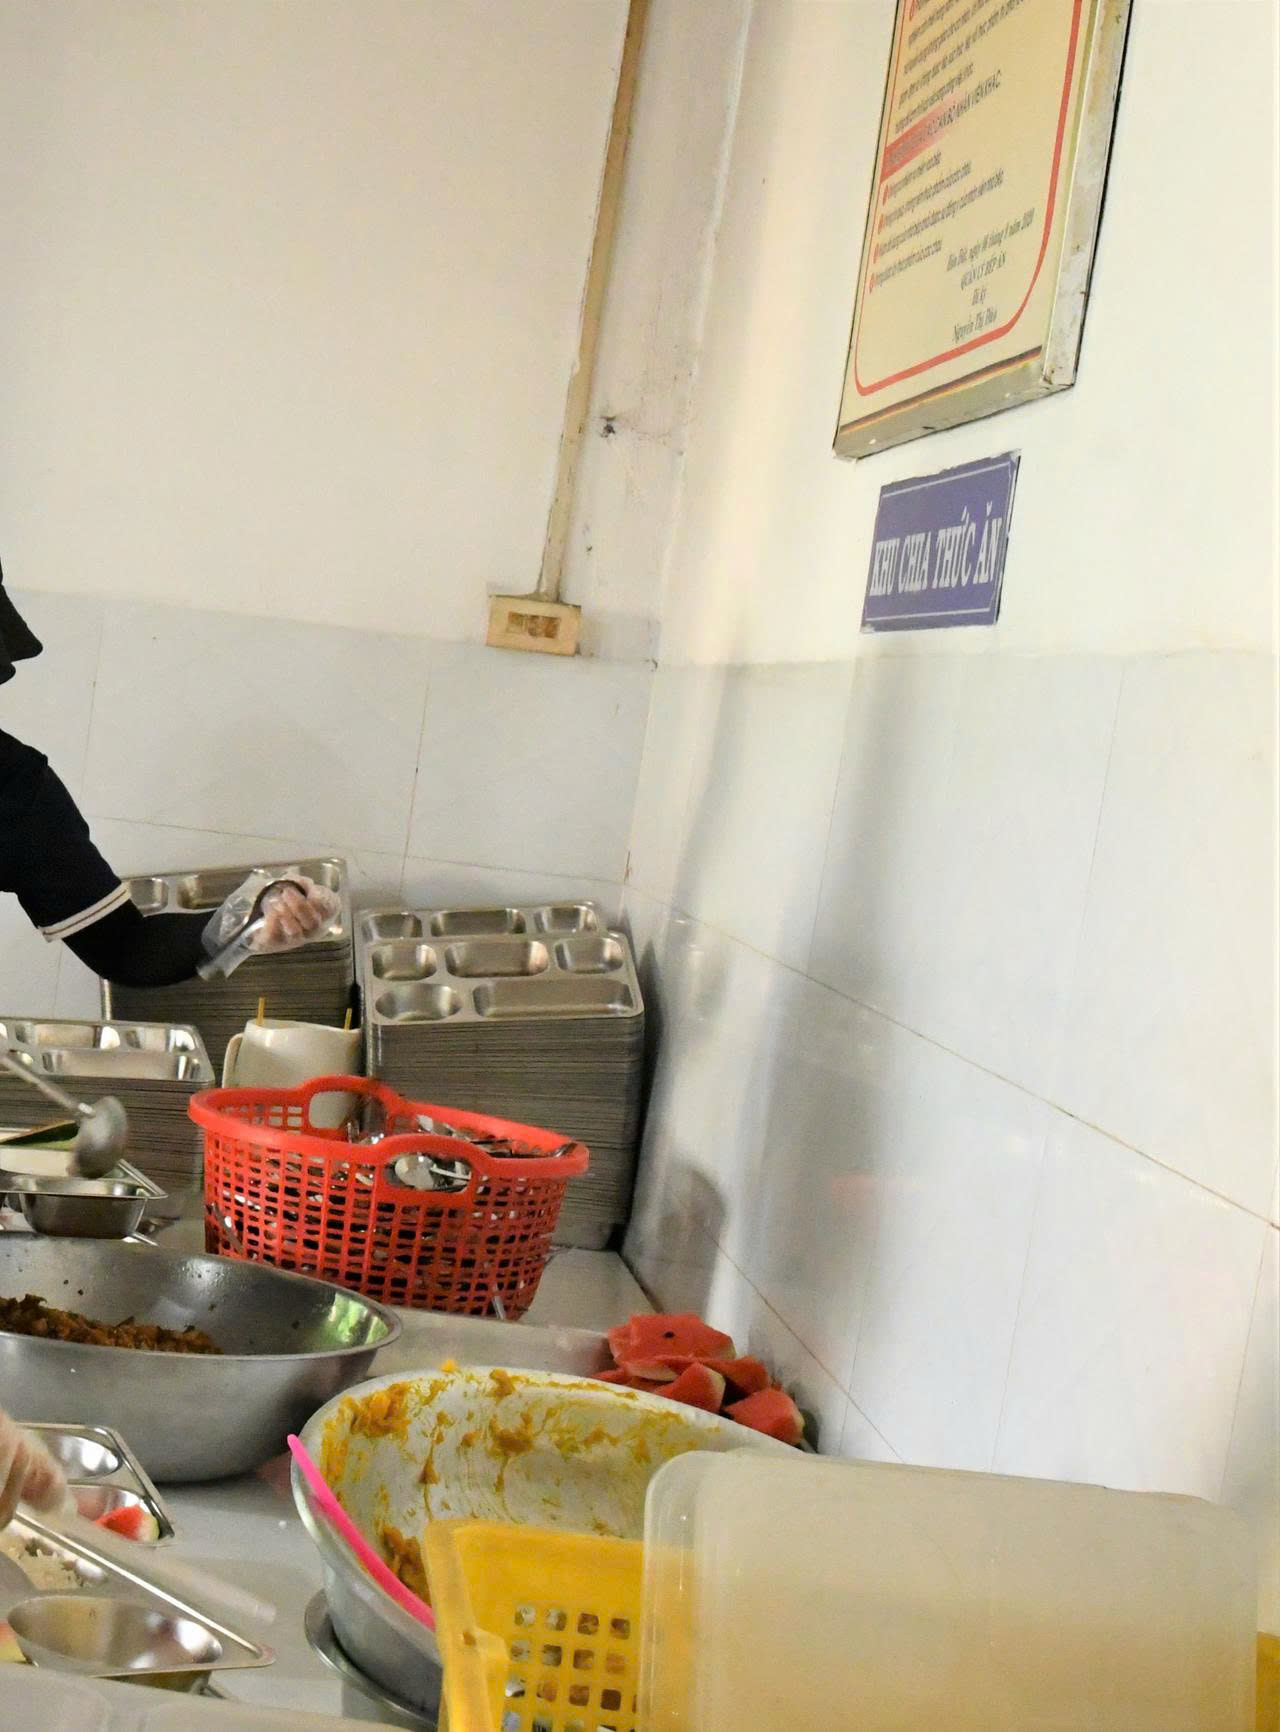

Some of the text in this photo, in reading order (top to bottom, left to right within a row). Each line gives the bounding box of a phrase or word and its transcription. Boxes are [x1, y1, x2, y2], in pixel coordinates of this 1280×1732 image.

[870, 500, 1003, 597] KHU CHIA THỨC ĂN
